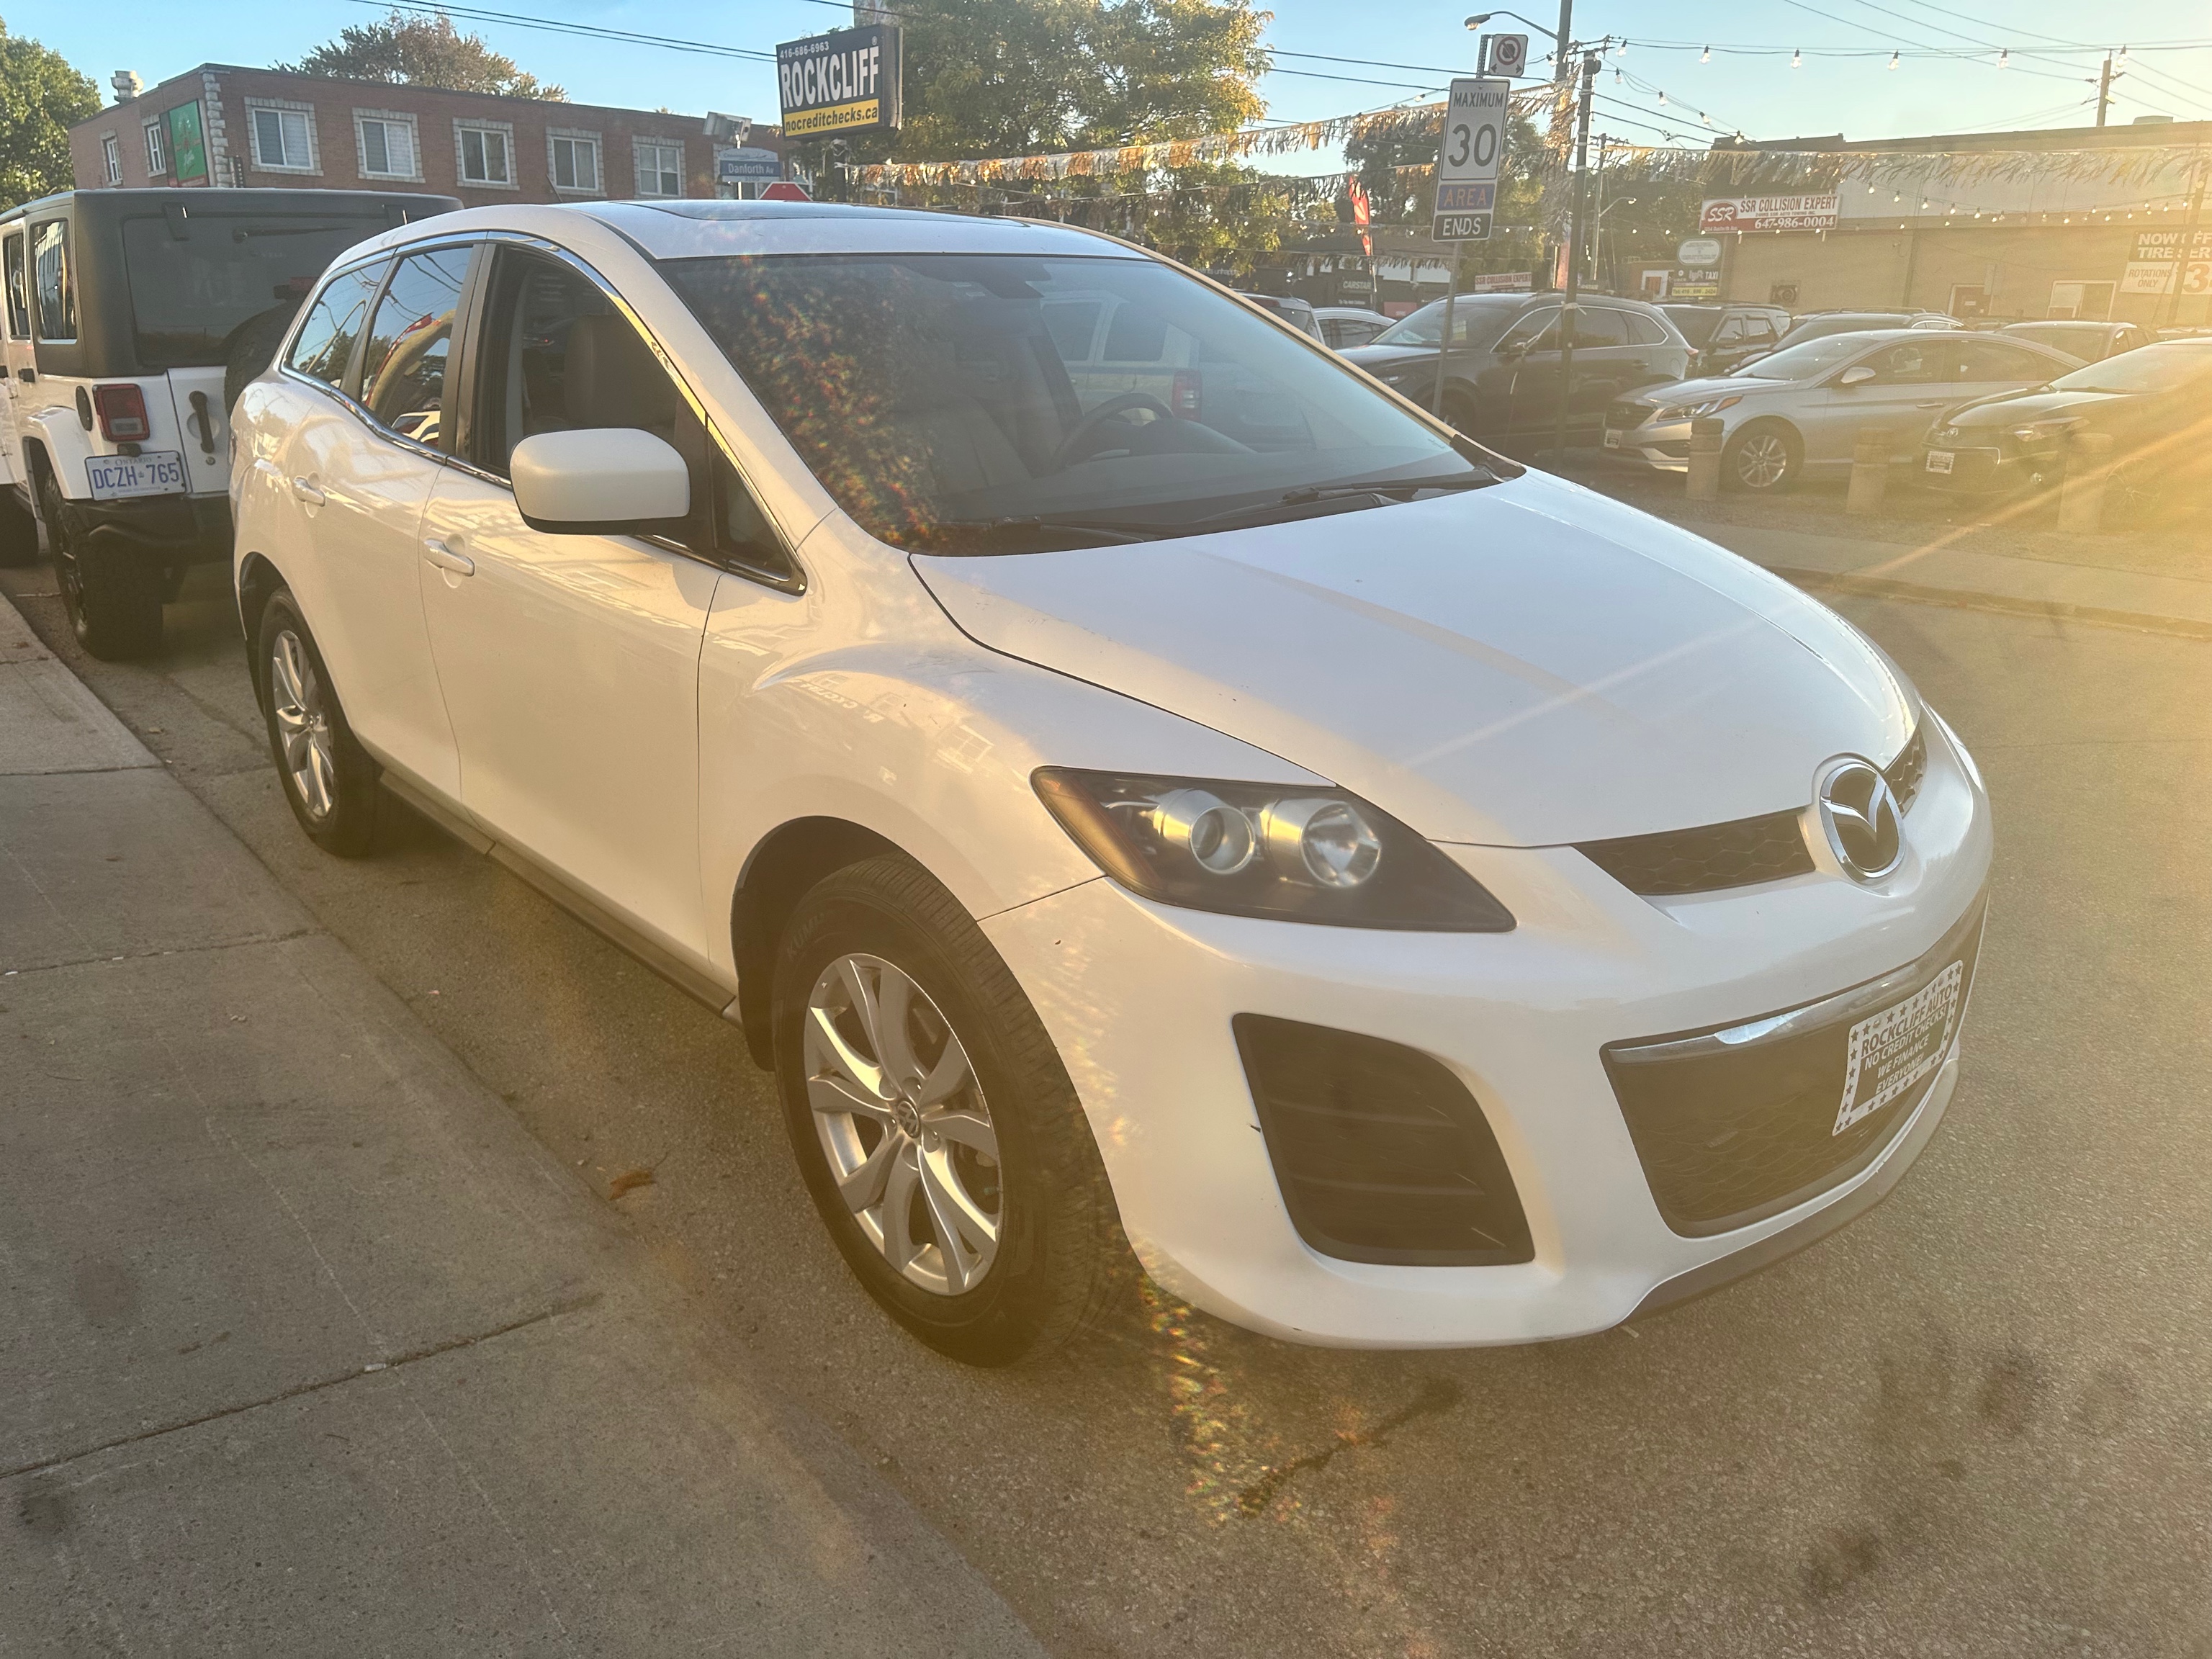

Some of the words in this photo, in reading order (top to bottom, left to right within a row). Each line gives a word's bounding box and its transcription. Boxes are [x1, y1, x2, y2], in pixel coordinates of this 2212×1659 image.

[780, 41, 830, 58] 416-686-6963
[781, 46, 879, 108] ROCKCLIFF
[1453, 93, 1504, 107] MAXIMUM
[786, 107, 878, 132] nocreditchecks.ca
[1448, 123, 1496, 167] 30
[729, 163, 764, 174] Danforth
[1444, 188, 1486, 207] AREA
[1740, 200, 1756, 213] SSR
[1758, 198, 1801, 212] COLLISION
[1804, 196, 1837, 210] EXPERT
[1708, 206, 1734, 222] SSR
[1754, 216, 1834, 229] 647-986-0004
[1443, 217, 1482, 235] ENDS
[2138, 233, 2178, 245] NOW
[2137, 247, 2174, 258] TIRE
[1486, 274, 1512, 284] COLLISION
[1513, 273, 1532, 283] EXPERT
[2128, 269, 2172, 278] ROTATIONS
[1342, 281, 1372, 289] CARSTAR
[92, 466, 138, 489] DCZH
[146, 463, 179, 484] 765
[1861, 1004, 1926, 1057] ROCKCLIFF
[1926, 984, 1953, 1016] AUTO
[1865, 1051, 1879, 1071] NO
[1881, 1032, 1915, 1059] CREDIT
[1914, 1003, 1948, 1038] CHECKS!
[1877, 1060, 1893, 1079] WE
[1892, 1033, 1930, 1069] FINANCE
[1876, 1053, 1925, 1094] EVERYONE!
